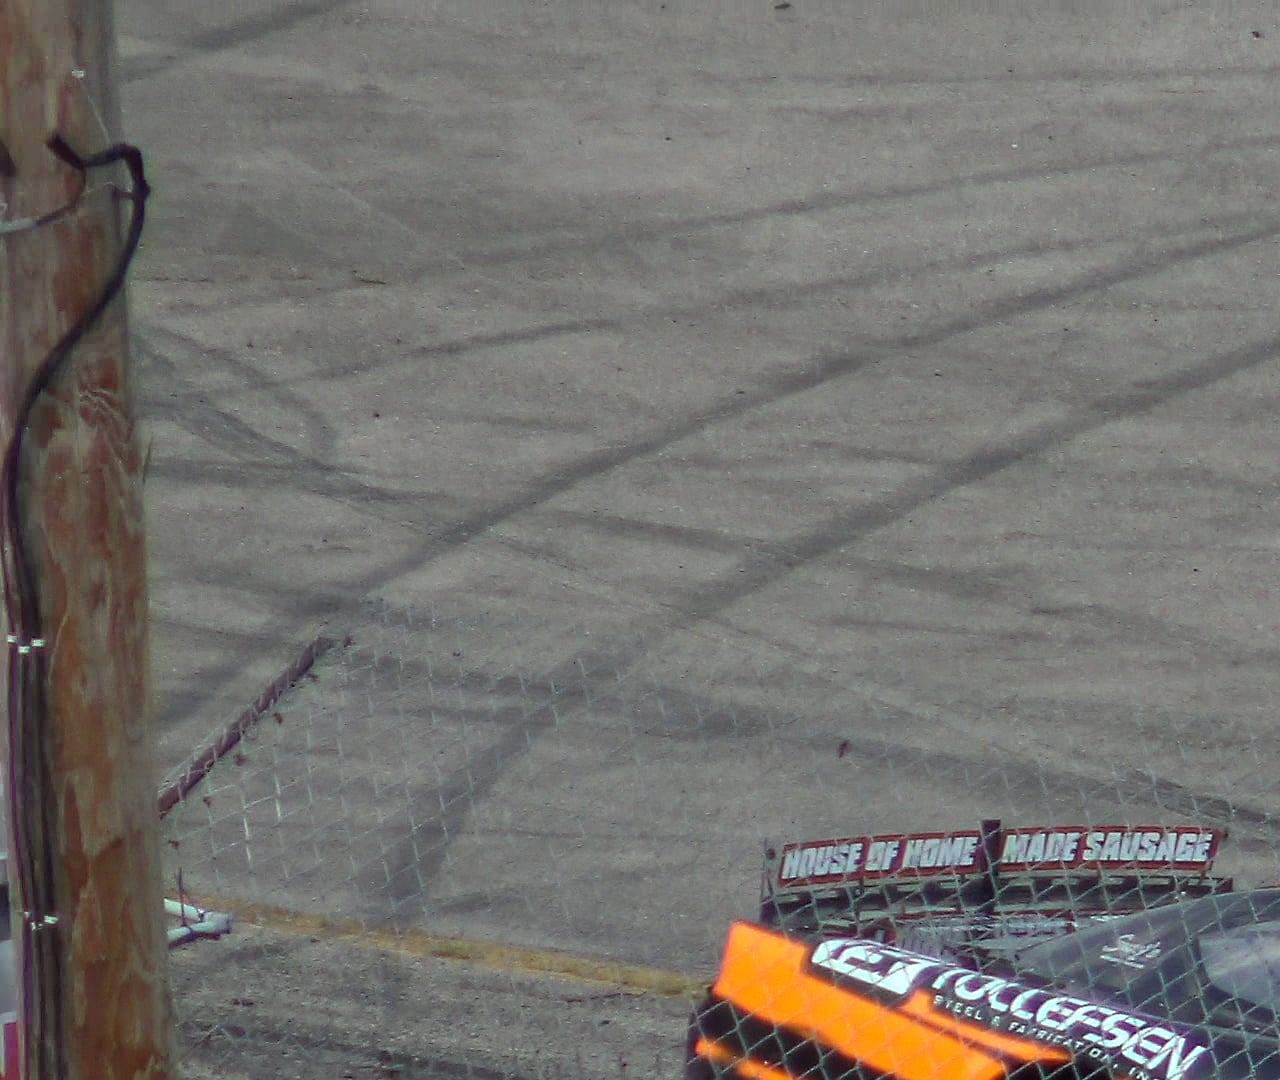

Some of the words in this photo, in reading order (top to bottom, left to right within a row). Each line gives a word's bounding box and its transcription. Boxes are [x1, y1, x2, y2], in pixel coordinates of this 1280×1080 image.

[782, 842, 863, 880] HOUSE
[864, 840, 898, 872] OF
[902, 835, 980, 870] HOME
[1000, 832, 1081, 864] MADE
[1082, 831, 1214, 863] SAUSAGE
[933, 994, 982, 1021] STEEL
[1008, 1021, 1118, 1069] FARICATON,
